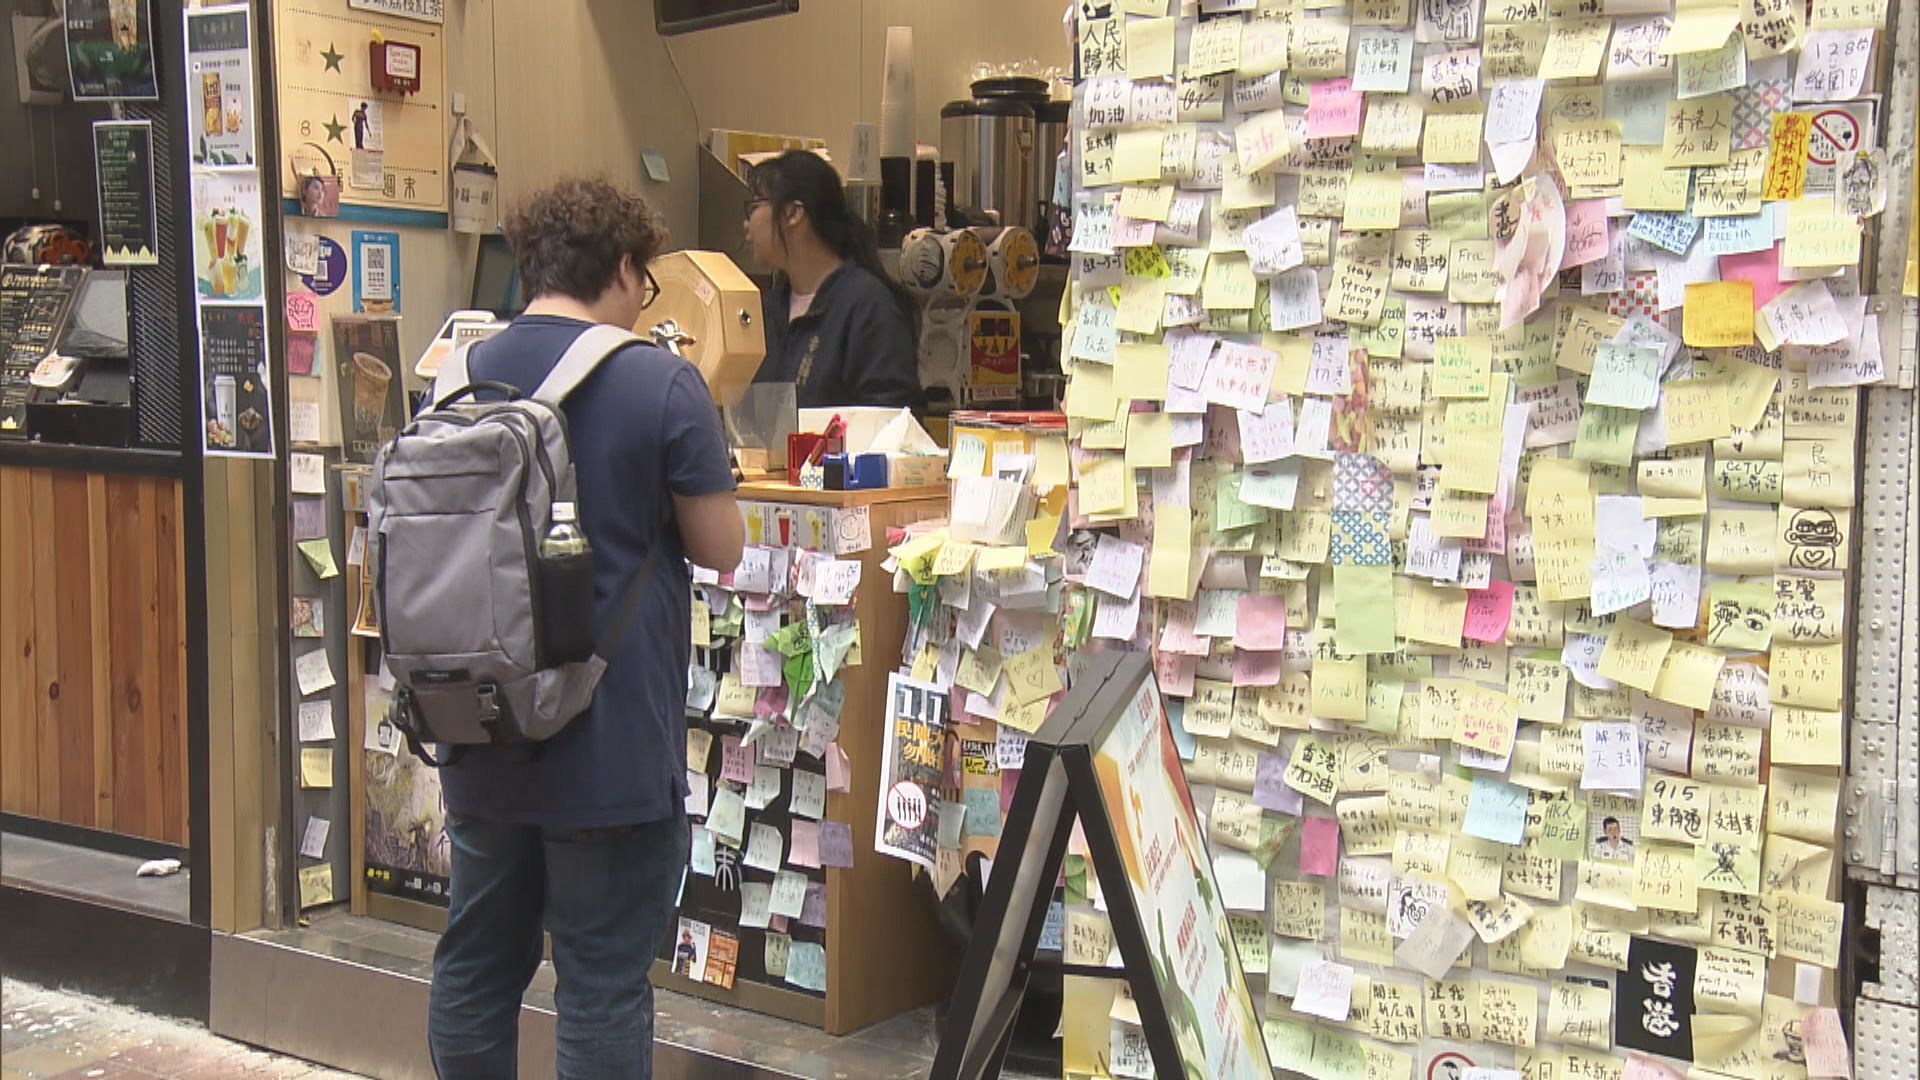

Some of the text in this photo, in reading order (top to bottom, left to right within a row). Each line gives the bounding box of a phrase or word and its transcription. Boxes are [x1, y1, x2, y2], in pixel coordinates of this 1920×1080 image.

[1082, 20, 1122, 46] 人民
[1089, 107, 1125, 128] 加油
[1674, 136, 1718, 159] 加油
[1301, 743, 1336, 772] 香港
[1291, 764, 1335, 793] 加油
[1654, 780, 1699, 801] 915
[1543, 822, 1580, 841] 加油
[1723, 908, 1765, 926] 加油
[1776, 896, 1837, 932] Blessing
[1784, 920, 1824, 944] Hong
